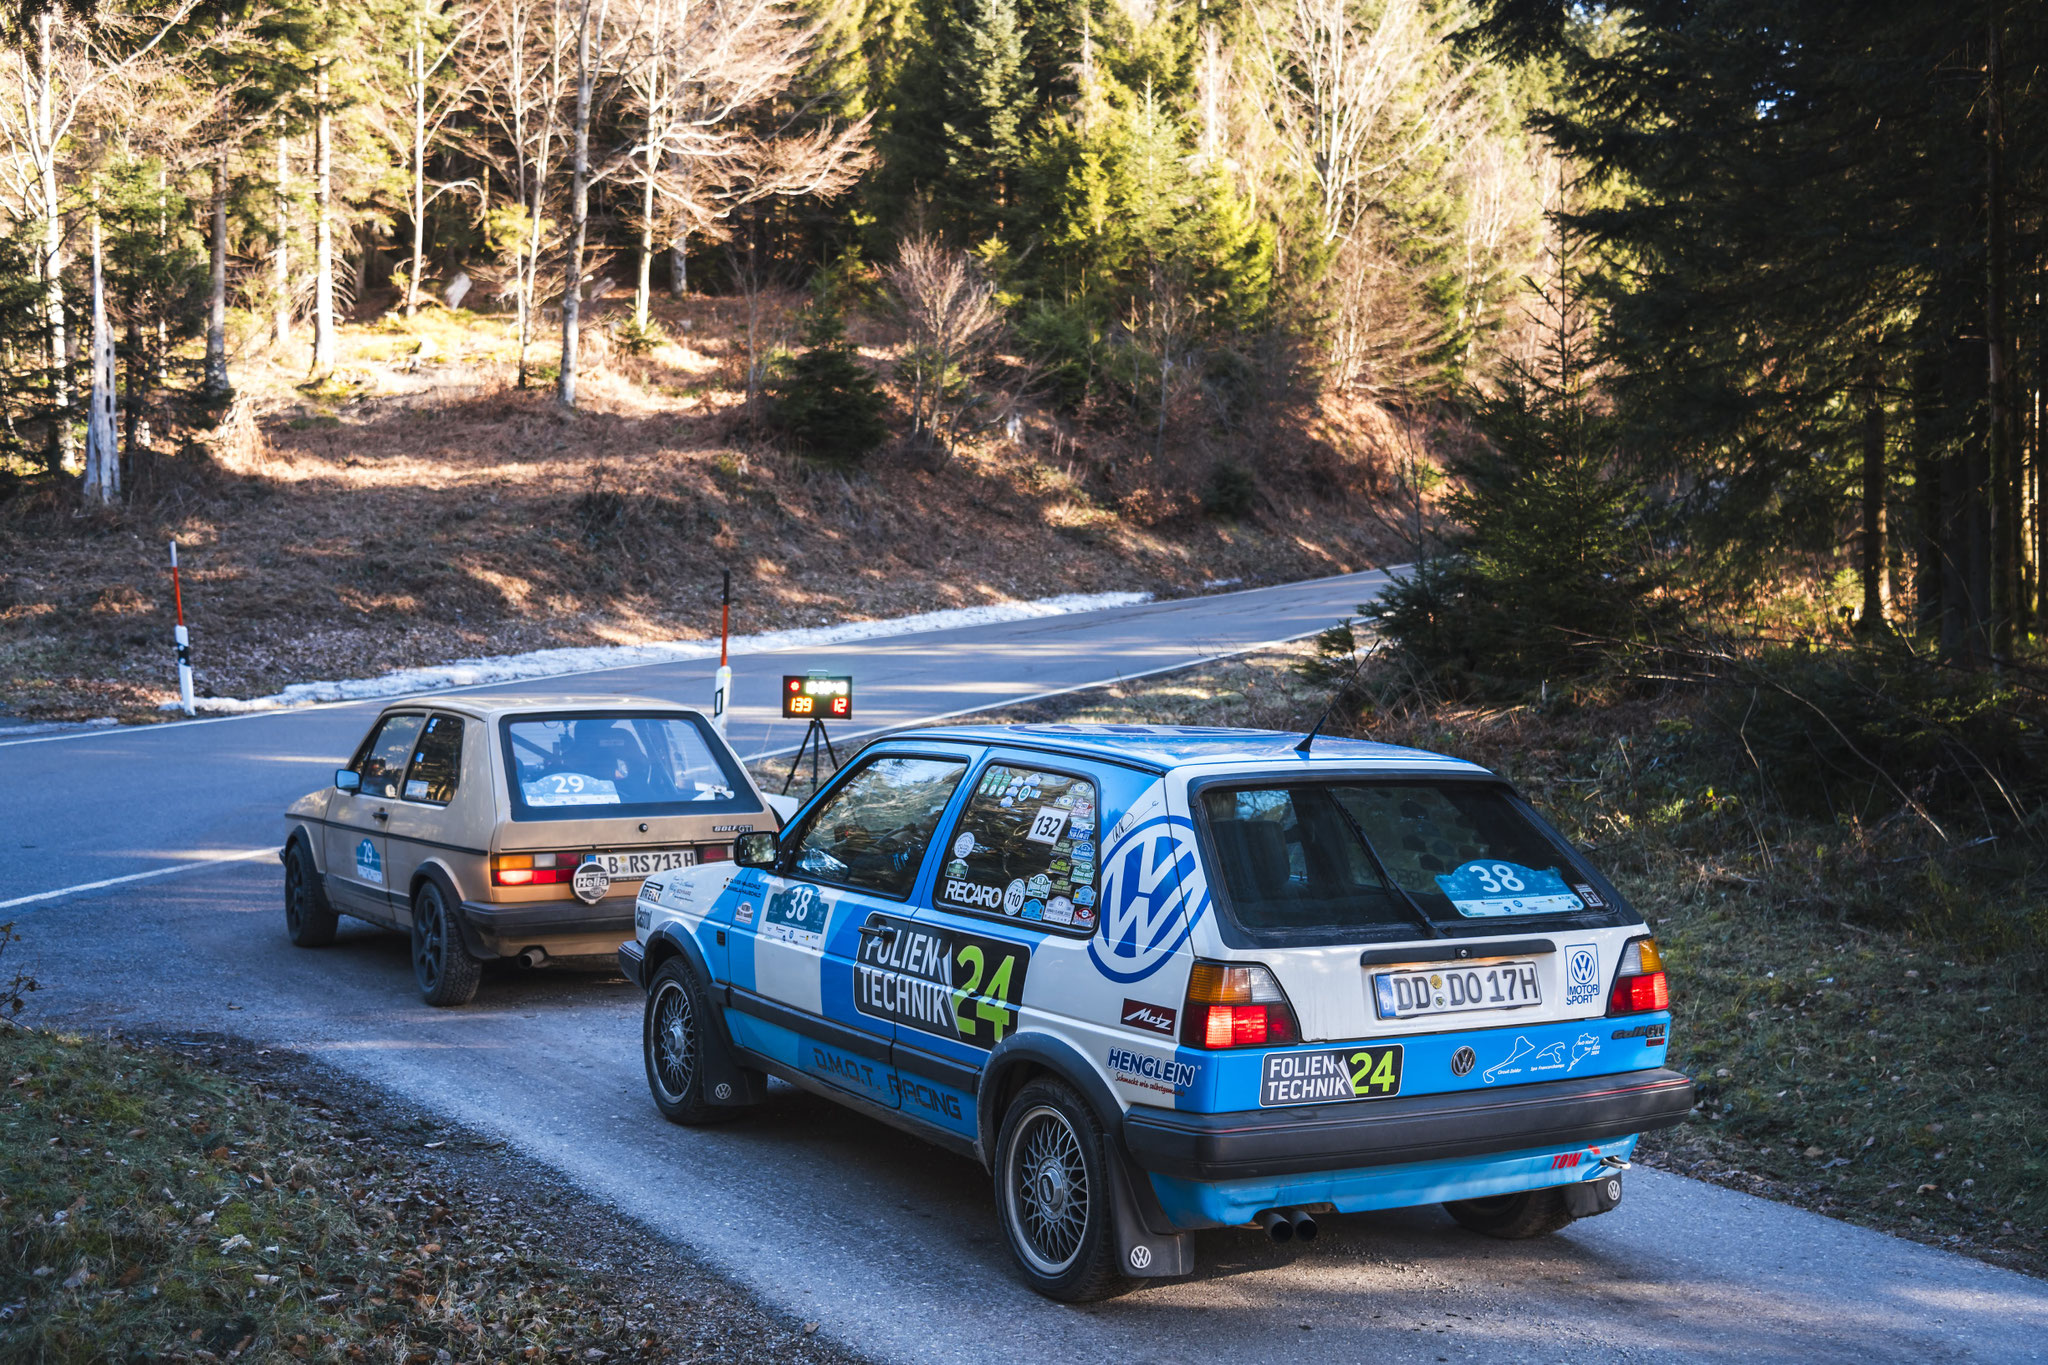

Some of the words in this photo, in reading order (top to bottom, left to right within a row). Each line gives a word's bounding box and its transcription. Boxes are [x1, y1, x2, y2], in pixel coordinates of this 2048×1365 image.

[790, 697, 813, 713] 139
[833, 697, 848, 713] 12
[551, 775, 585, 793] 29
[738, 825, 753, 833] GTI
[1034, 815, 1062, 838] 132
[628, 855, 651, 873] RS
[577, 877, 608, 888] Hella
[1468, 864, 1525, 893] 38
[785, 886, 813, 921] 38
[944, 880, 1002, 909] RECARO
[1007, 891, 1021, 907] 110
[860, 967, 948, 1027] TECHNIK
[953, 944, 1015, 1043] 24
[1392, 976, 1431, 1011] DD
[1446, 971, 1482, 1006] DO
[1486, 967, 1539, 1003] 17H
[1566, 994, 1593, 1006] SPORT
[1569, 983, 1598, 996] MOTOR
[1123, 1007, 1172, 1031] Metz
[1645, 1023, 1666, 1038] GTI
[1107, 1047, 1195, 1087] HENGLEIN
[1269, 1055, 1336, 1079] FOLIEN
[1350, 1050, 1396, 1095] 24
[1139, 1080, 1149, 1089] wie
[1267, 1076, 1347, 1101] TECHNIK
[887, 1073, 962, 1120] RACING
[1551, 1152, 1582, 1170] TOW
